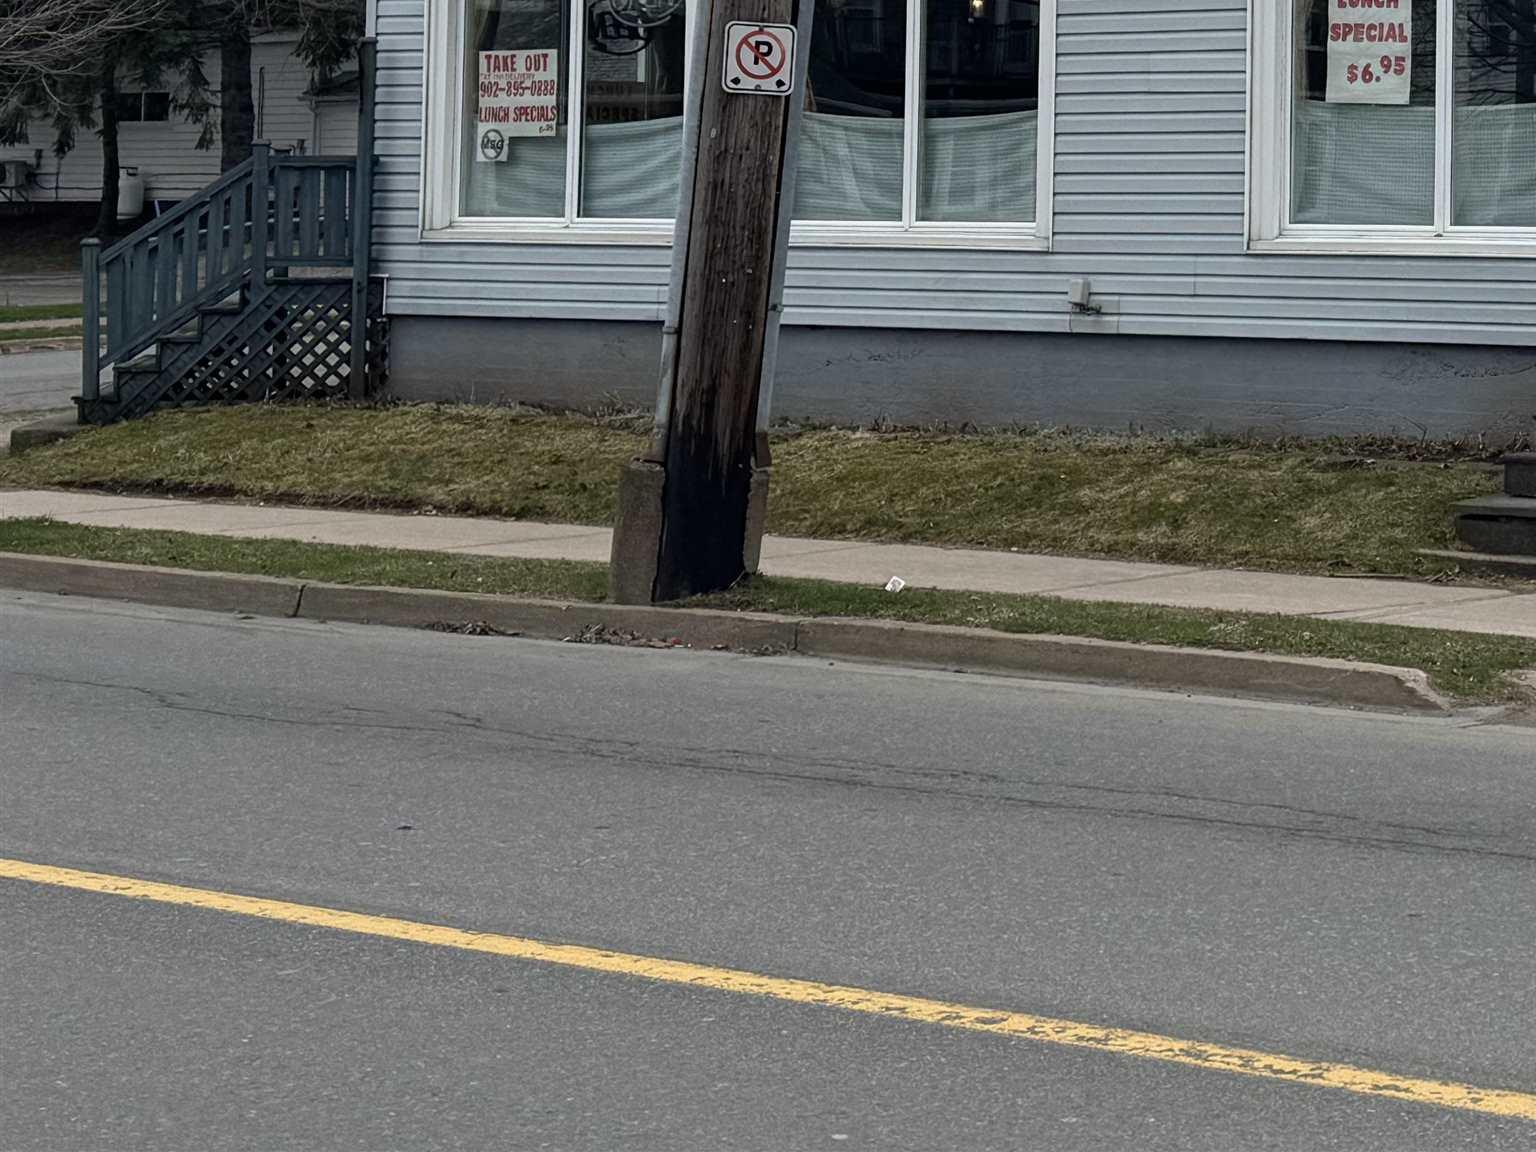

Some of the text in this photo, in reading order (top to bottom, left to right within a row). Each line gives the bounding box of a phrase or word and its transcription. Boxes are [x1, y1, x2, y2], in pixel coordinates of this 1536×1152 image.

[1330, 22, 1408, 43] SPECIAL
[484, 53, 549, 73] TAKE OUT
[753, 40, 774, 66] P
[1346, 55, 1406, 85] $6.95
[480, 79, 556, 98] 902-895-0888
[480, 105, 557, 123] LUNCH SPECIALS
